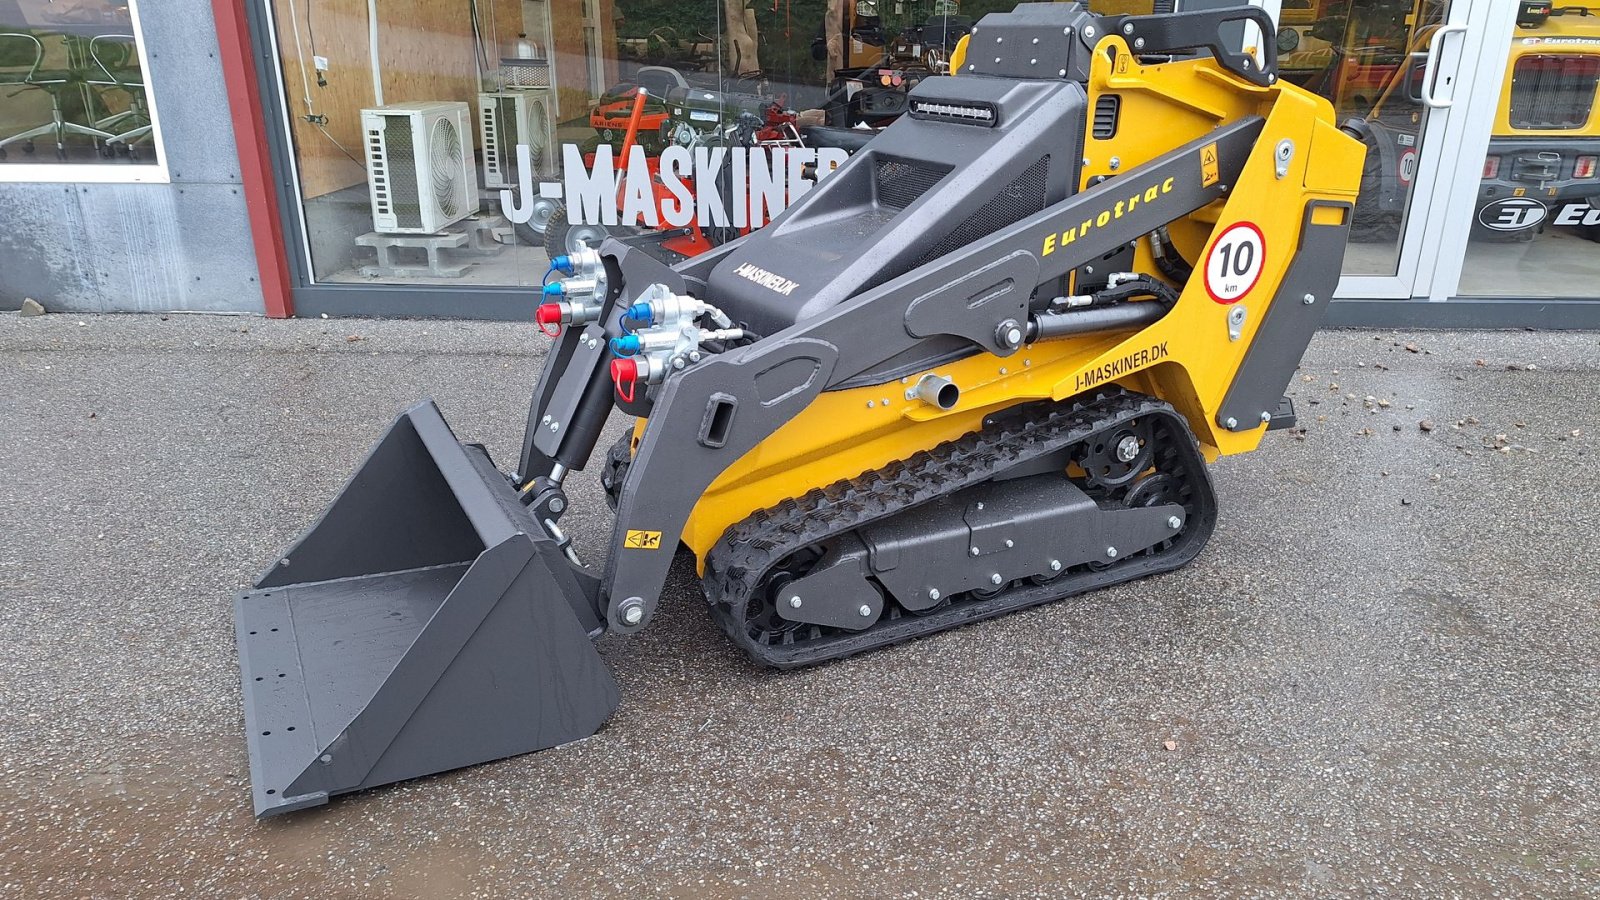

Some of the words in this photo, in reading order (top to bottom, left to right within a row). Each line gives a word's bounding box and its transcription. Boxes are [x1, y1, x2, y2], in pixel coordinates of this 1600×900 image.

[1404, 158, 1414, 175] 10
[1042, 176, 1175, 257] Eurotrac
[1220, 240, 1254, 278] 10
[1224, 283, 1238, 293] km
[1074, 340, 1169, 392] J-MASKINER.DK
